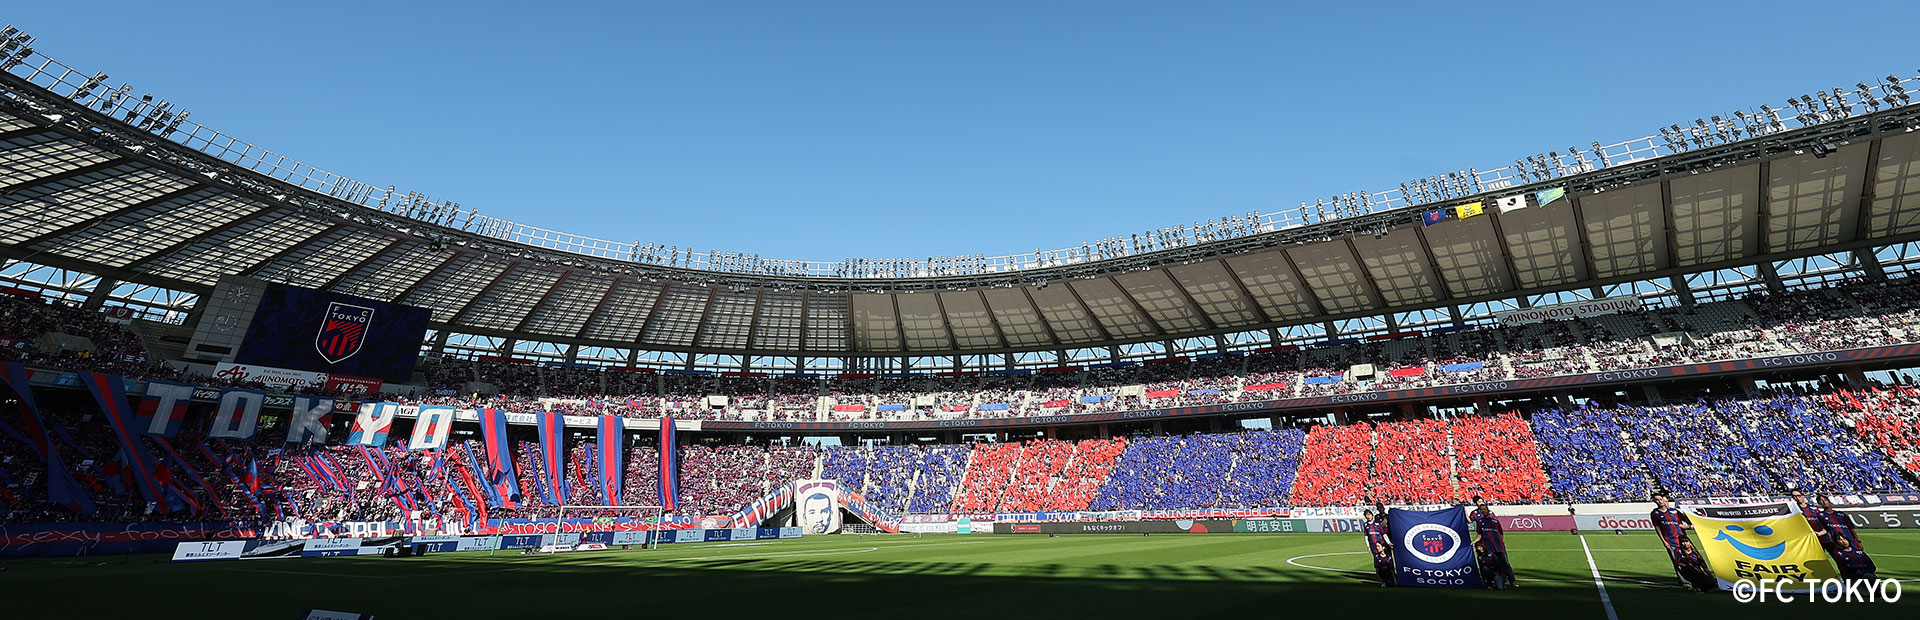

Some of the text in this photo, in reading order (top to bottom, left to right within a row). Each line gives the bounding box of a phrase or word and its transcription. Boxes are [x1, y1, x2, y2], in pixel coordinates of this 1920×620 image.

[1501, 299, 1637, 324] AJINOMOTO STADIUM
[332, 312, 366, 323] TOKYO
[1763, 352, 1837, 367] FC TOKYO
[251, 375, 306, 385] AJINOMOTO
[1596, 368, 1658, 381] FC TOKYO
[1454, 382, 1508, 393] FC TOKYO
[193, 389, 221, 400] バイタル
[1346, 393, 1378, 401] TOKYO
[1235, 402, 1264, 410] TOKYO
[1246, 520, 1293, 532] 明治安田
[1598, 516, 1654, 529] docom
[201, 541, 225, 552] TLT
[473, 538, 488, 546] TLT
[515, 537, 530, 545] TLT
[426, 543, 443, 552] TLT
[1403, 565, 1472, 578] FC TOKYO
[1734, 560, 1801, 574] FAIR
[1735, 568, 1807, 582] PLAY
[1417, 577, 1465, 585] SOCIO
